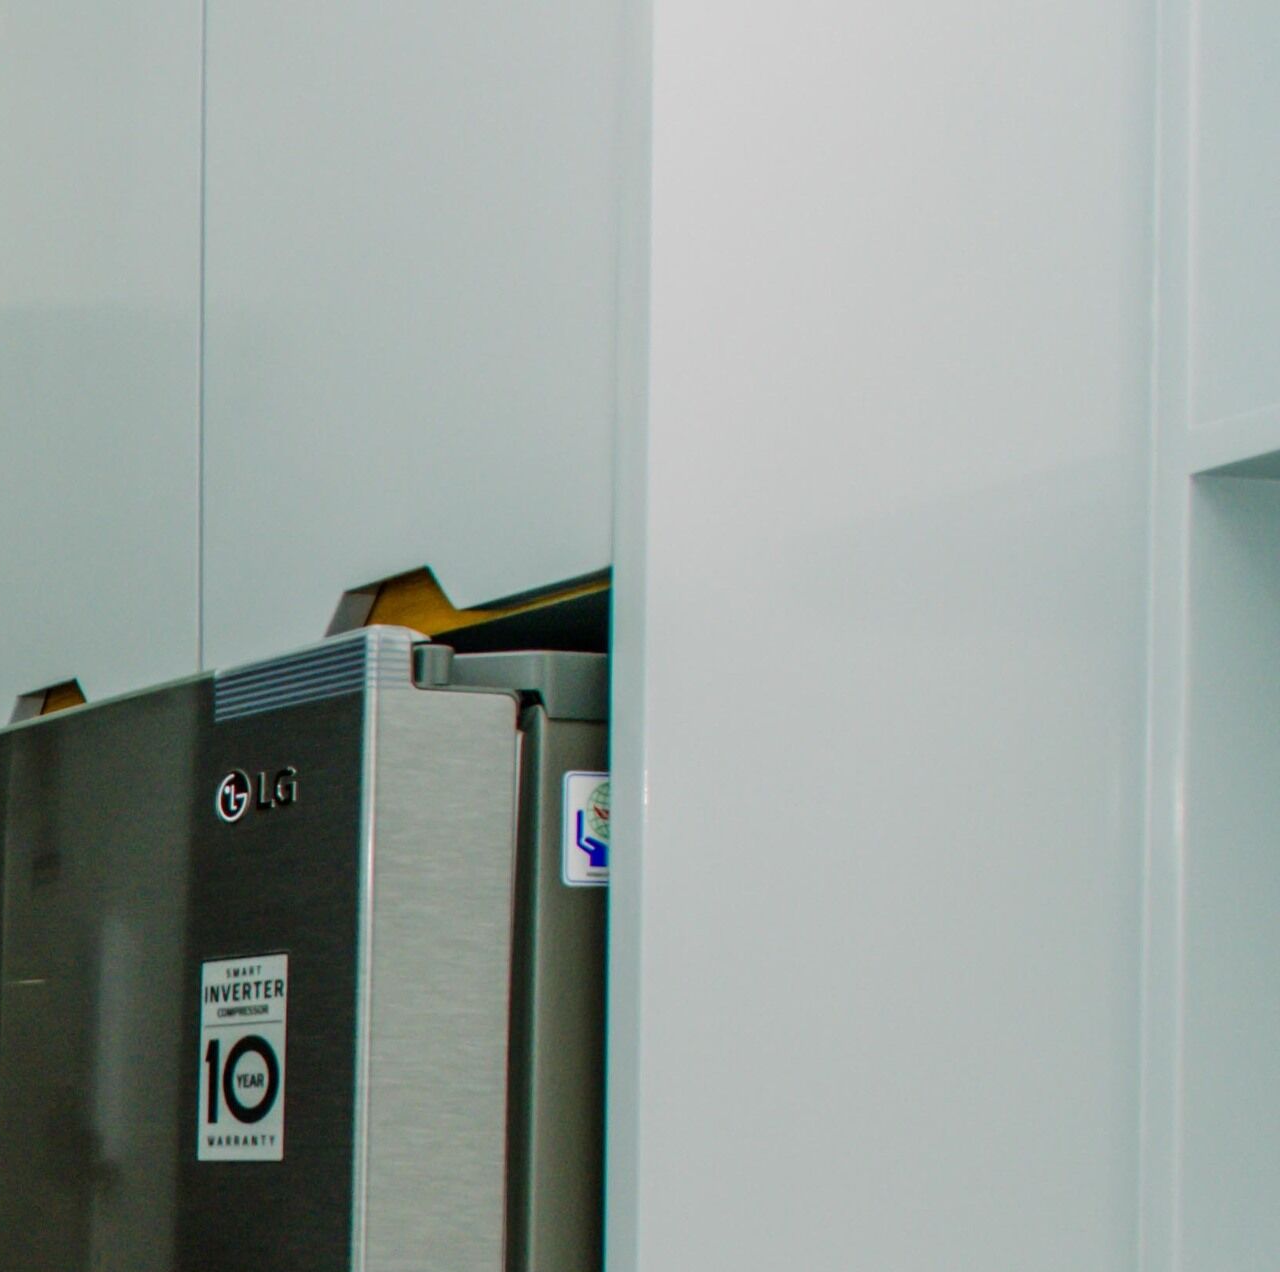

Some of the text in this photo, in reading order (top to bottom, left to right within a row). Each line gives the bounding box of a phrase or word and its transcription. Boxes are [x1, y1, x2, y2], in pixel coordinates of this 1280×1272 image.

[256, 766, 299, 810] LG
[226, 965, 261, 978] SMART
[204, 979, 284, 1004] INVERTER
[217, 1004, 269, 1018] COMPRESSOR
[205, 1034, 280, 1125] 10
[236, 1073, 265, 1089] YEAR
[207, 1135, 275, 1147] WARRANTY
